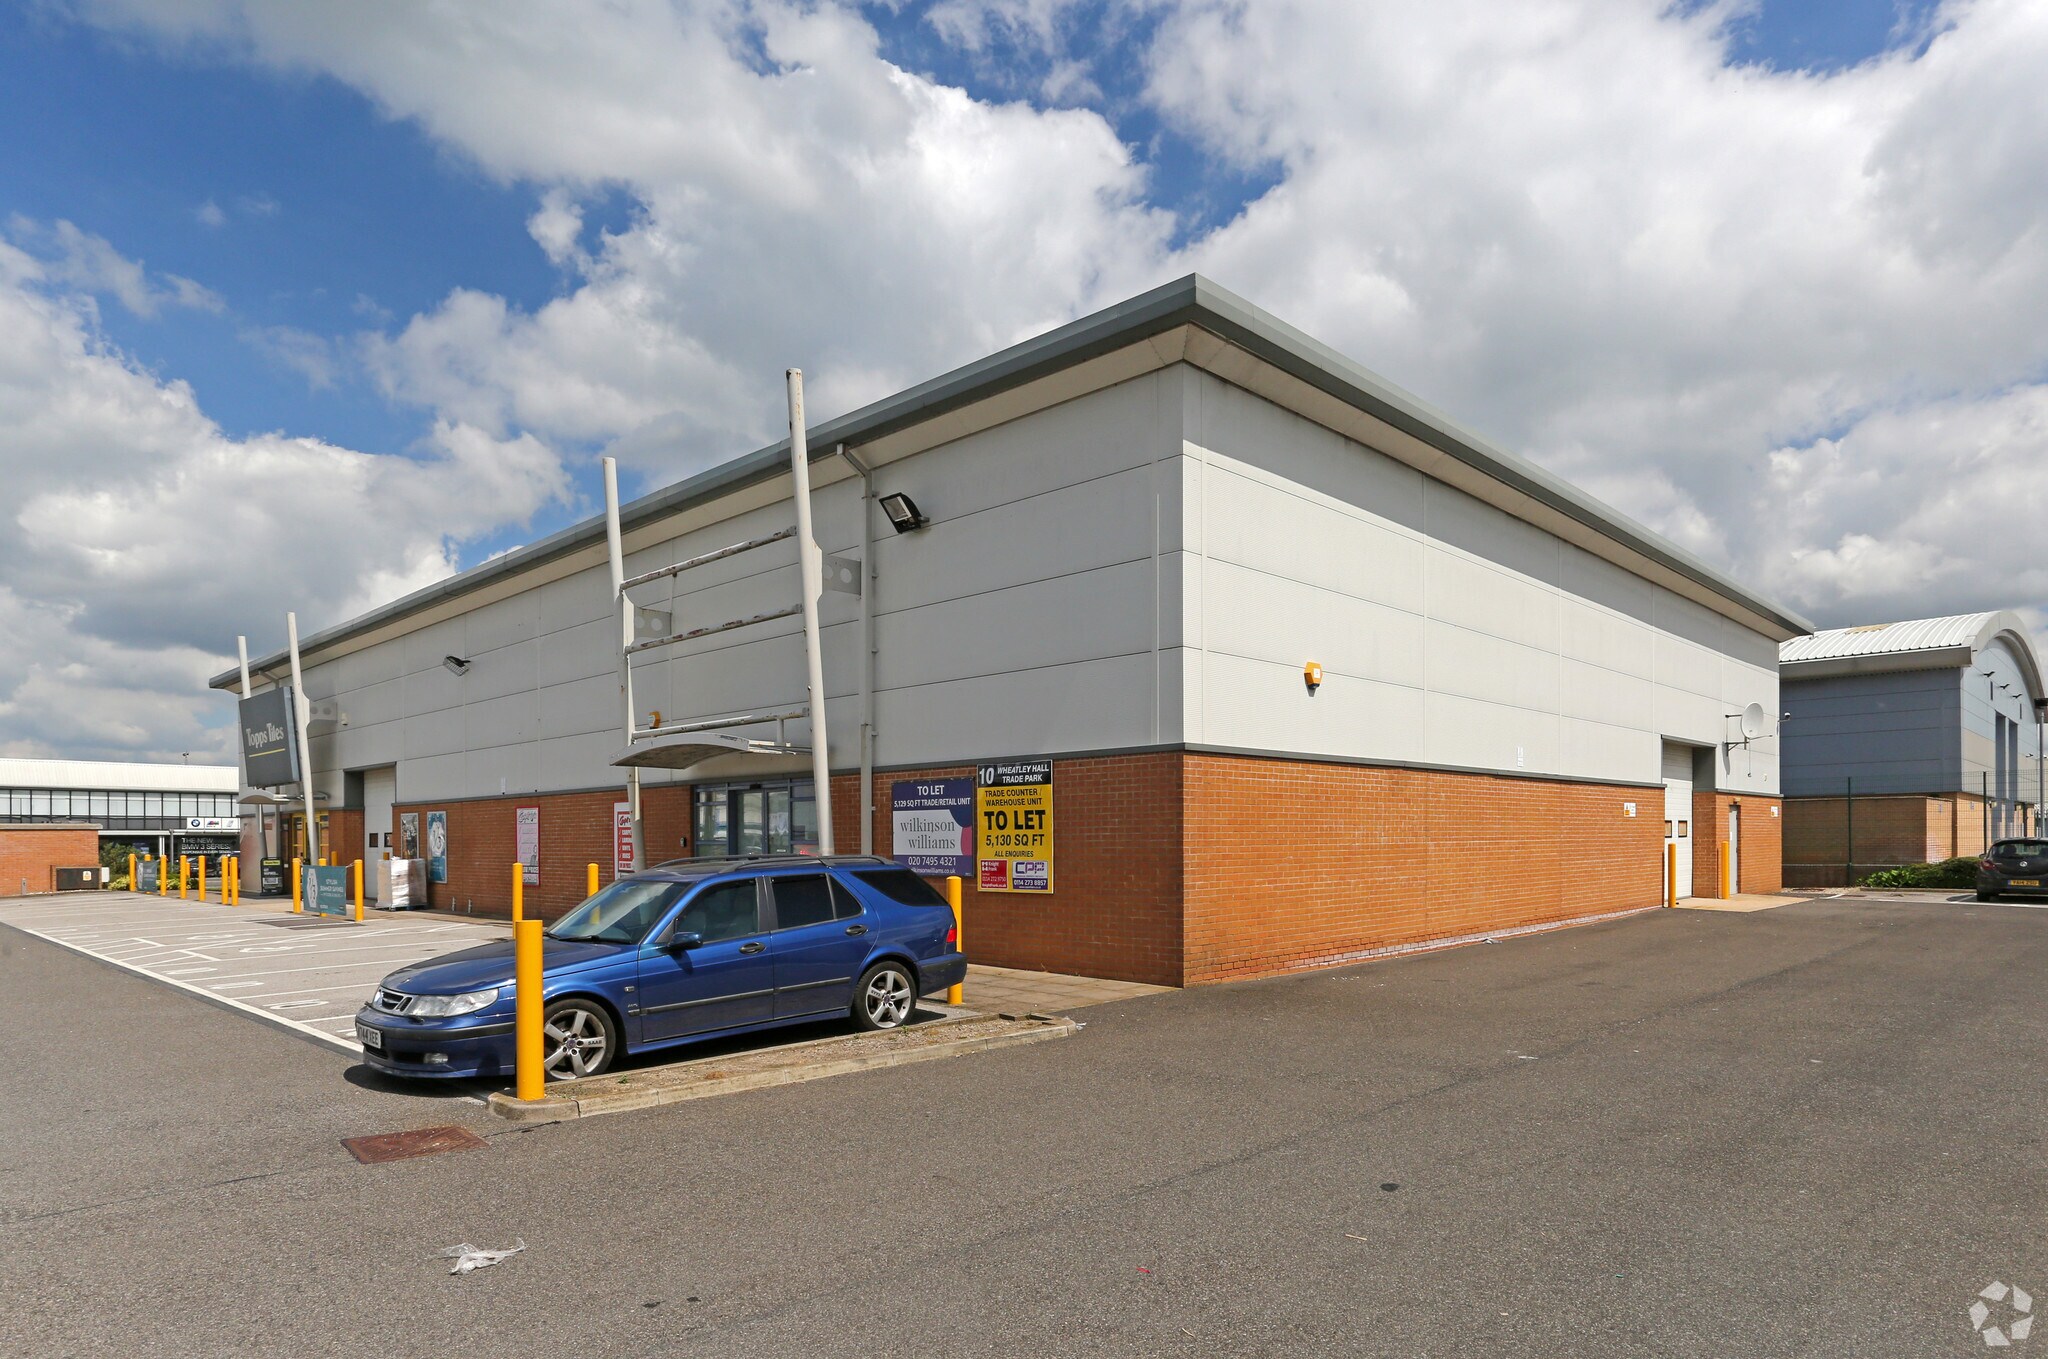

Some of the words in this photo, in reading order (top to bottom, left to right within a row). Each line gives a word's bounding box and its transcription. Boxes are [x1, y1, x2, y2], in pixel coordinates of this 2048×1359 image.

[246, 727, 268, 748] Topps
[266, 723, 284, 742] Tiles
[997, 765, 1032, 774] WHEATLEY
[1032, 764, 1049, 772] HALL
[979, 767, 995, 785] 10
[1002, 775, 1023, 783] TRADE
[1024, 774, 1043, 782] PARK
[917, 785, 929, 796] TO
[930, 785, 944, 795] LET
[985, 789, 1005, 797] TRADE
[1006, 788, 1038, 797] COUNTER
[921, 798, 957, 806] TRADE/RETAIL
[957, 797, 971, 805] UNIT
[985, 798, 1026, 806] WAREHOUSE
[1027, 797, 1042, 805] UNIT
[900, 817, 955, 832] wilkinson
[984, 810, 1008, 831] TO
[1013, 809, 1046, 830] LET
[908, 834, 956, 849] williams
[986, 834, 1011, 848] 5,130
[1014, 834, 1029, 846] SQ
[1032, 834, 1045, 846] FT
[908, 856, 920, 865] 020
[922, 856, 938, 865] 7495
[939, 857, 956, 866] 4321
